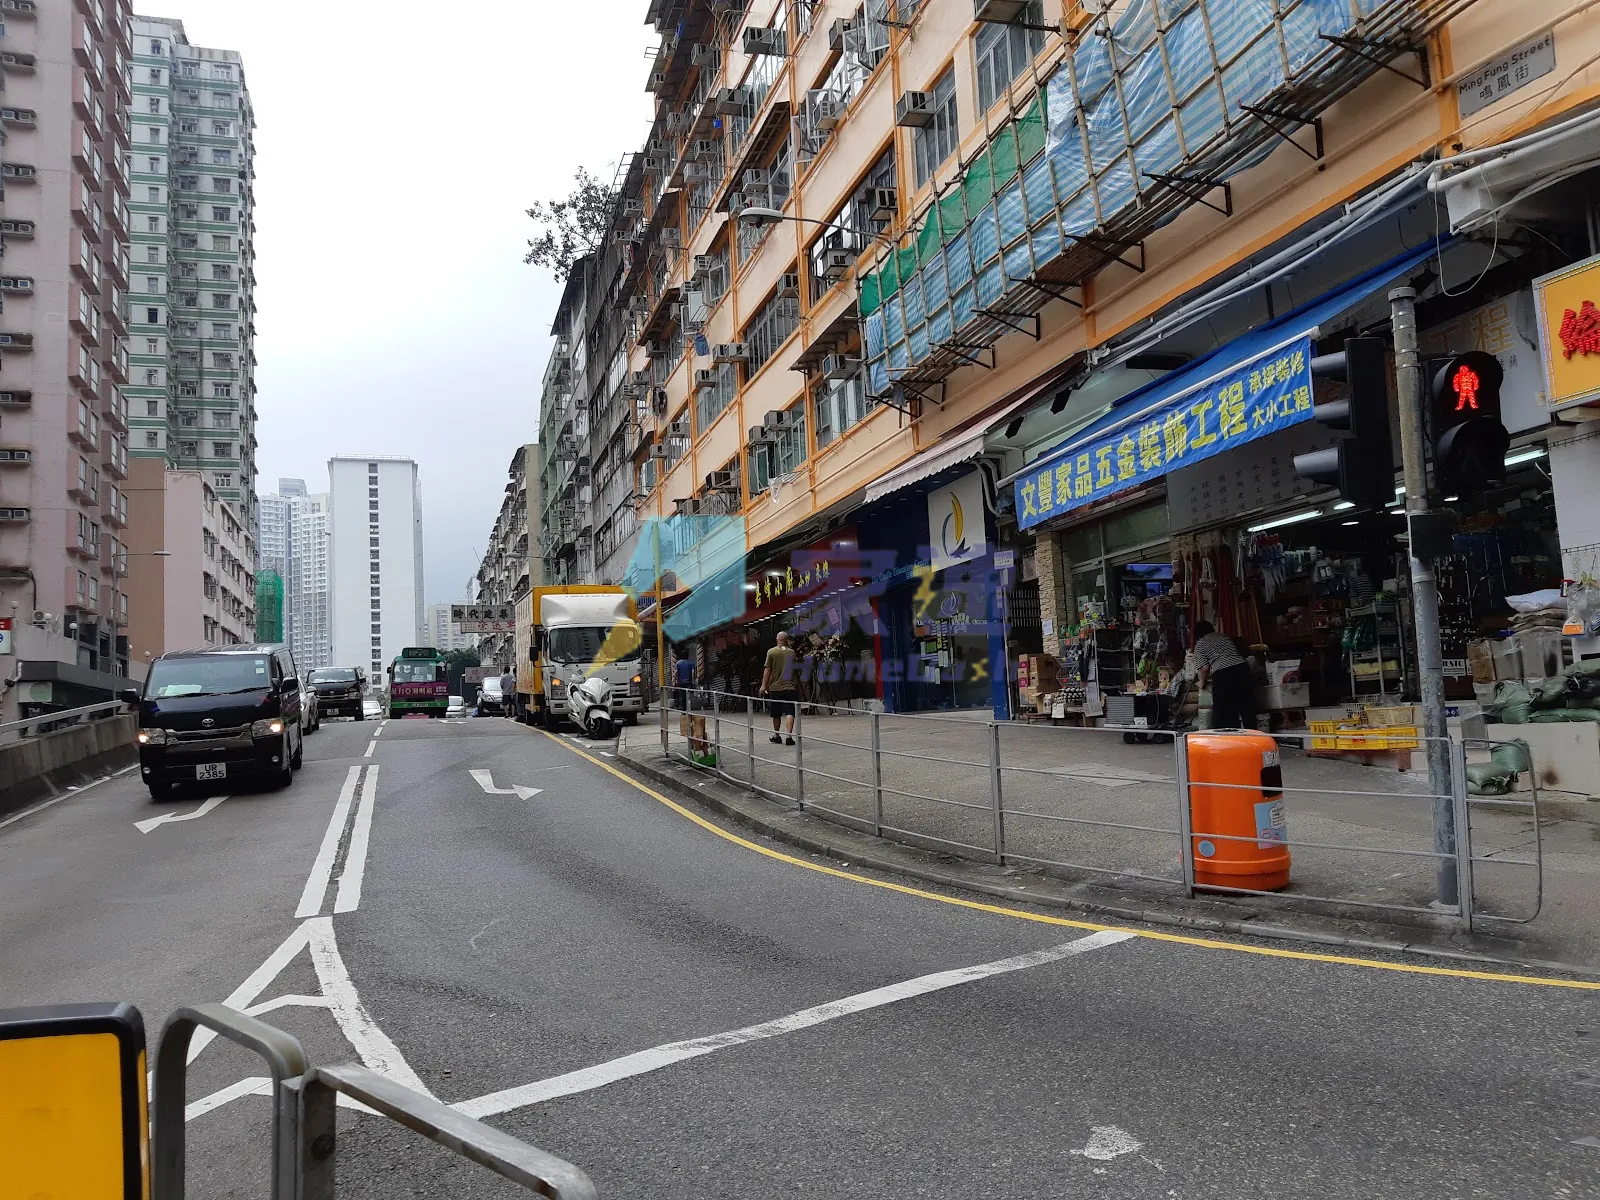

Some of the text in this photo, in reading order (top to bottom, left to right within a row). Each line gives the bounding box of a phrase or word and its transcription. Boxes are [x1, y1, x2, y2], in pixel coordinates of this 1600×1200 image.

[1459, 38, 1551, 95] Ming Fung Street
[1479, 63, 1530, 100] 鳴鳳街
[1248, 349, 1306, 396] 承接裝修
[1252, 384, 1312, 431] 大小工程
[1020, 380, 1249, 518] 文豐家品五金裝飾工程
[199, 770, 224, 778] 2385
